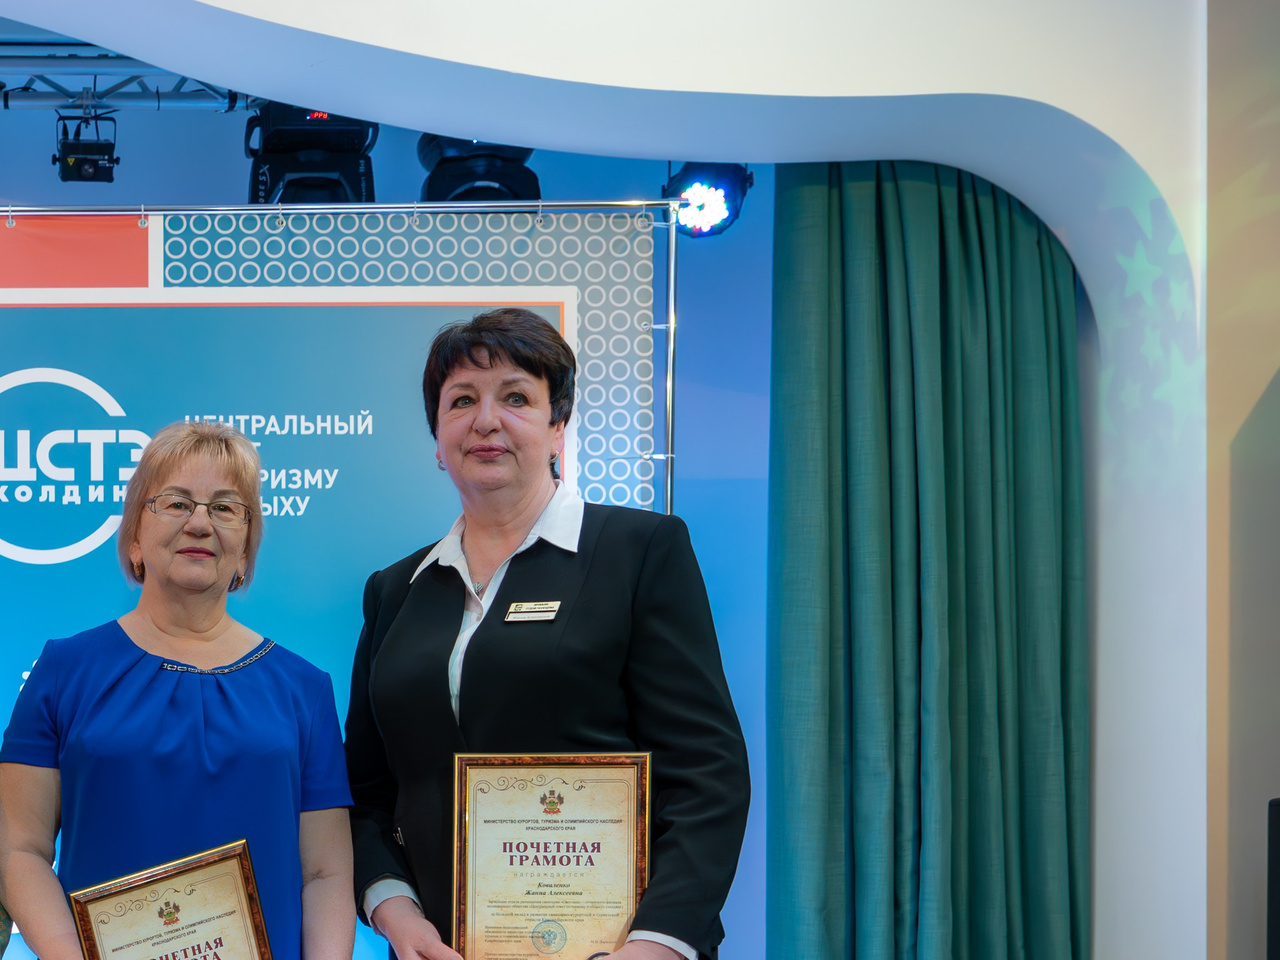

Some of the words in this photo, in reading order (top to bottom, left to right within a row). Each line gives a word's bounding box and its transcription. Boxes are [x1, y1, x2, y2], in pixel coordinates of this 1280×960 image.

[260, 468, 339, 489] РИЗМУ
[261, 496, 310, 516] ЫХУ
[502, 841, 602, 853] ПОЧЕТНАЯ
[509, 855, 595, 866] ГРАМОТА
